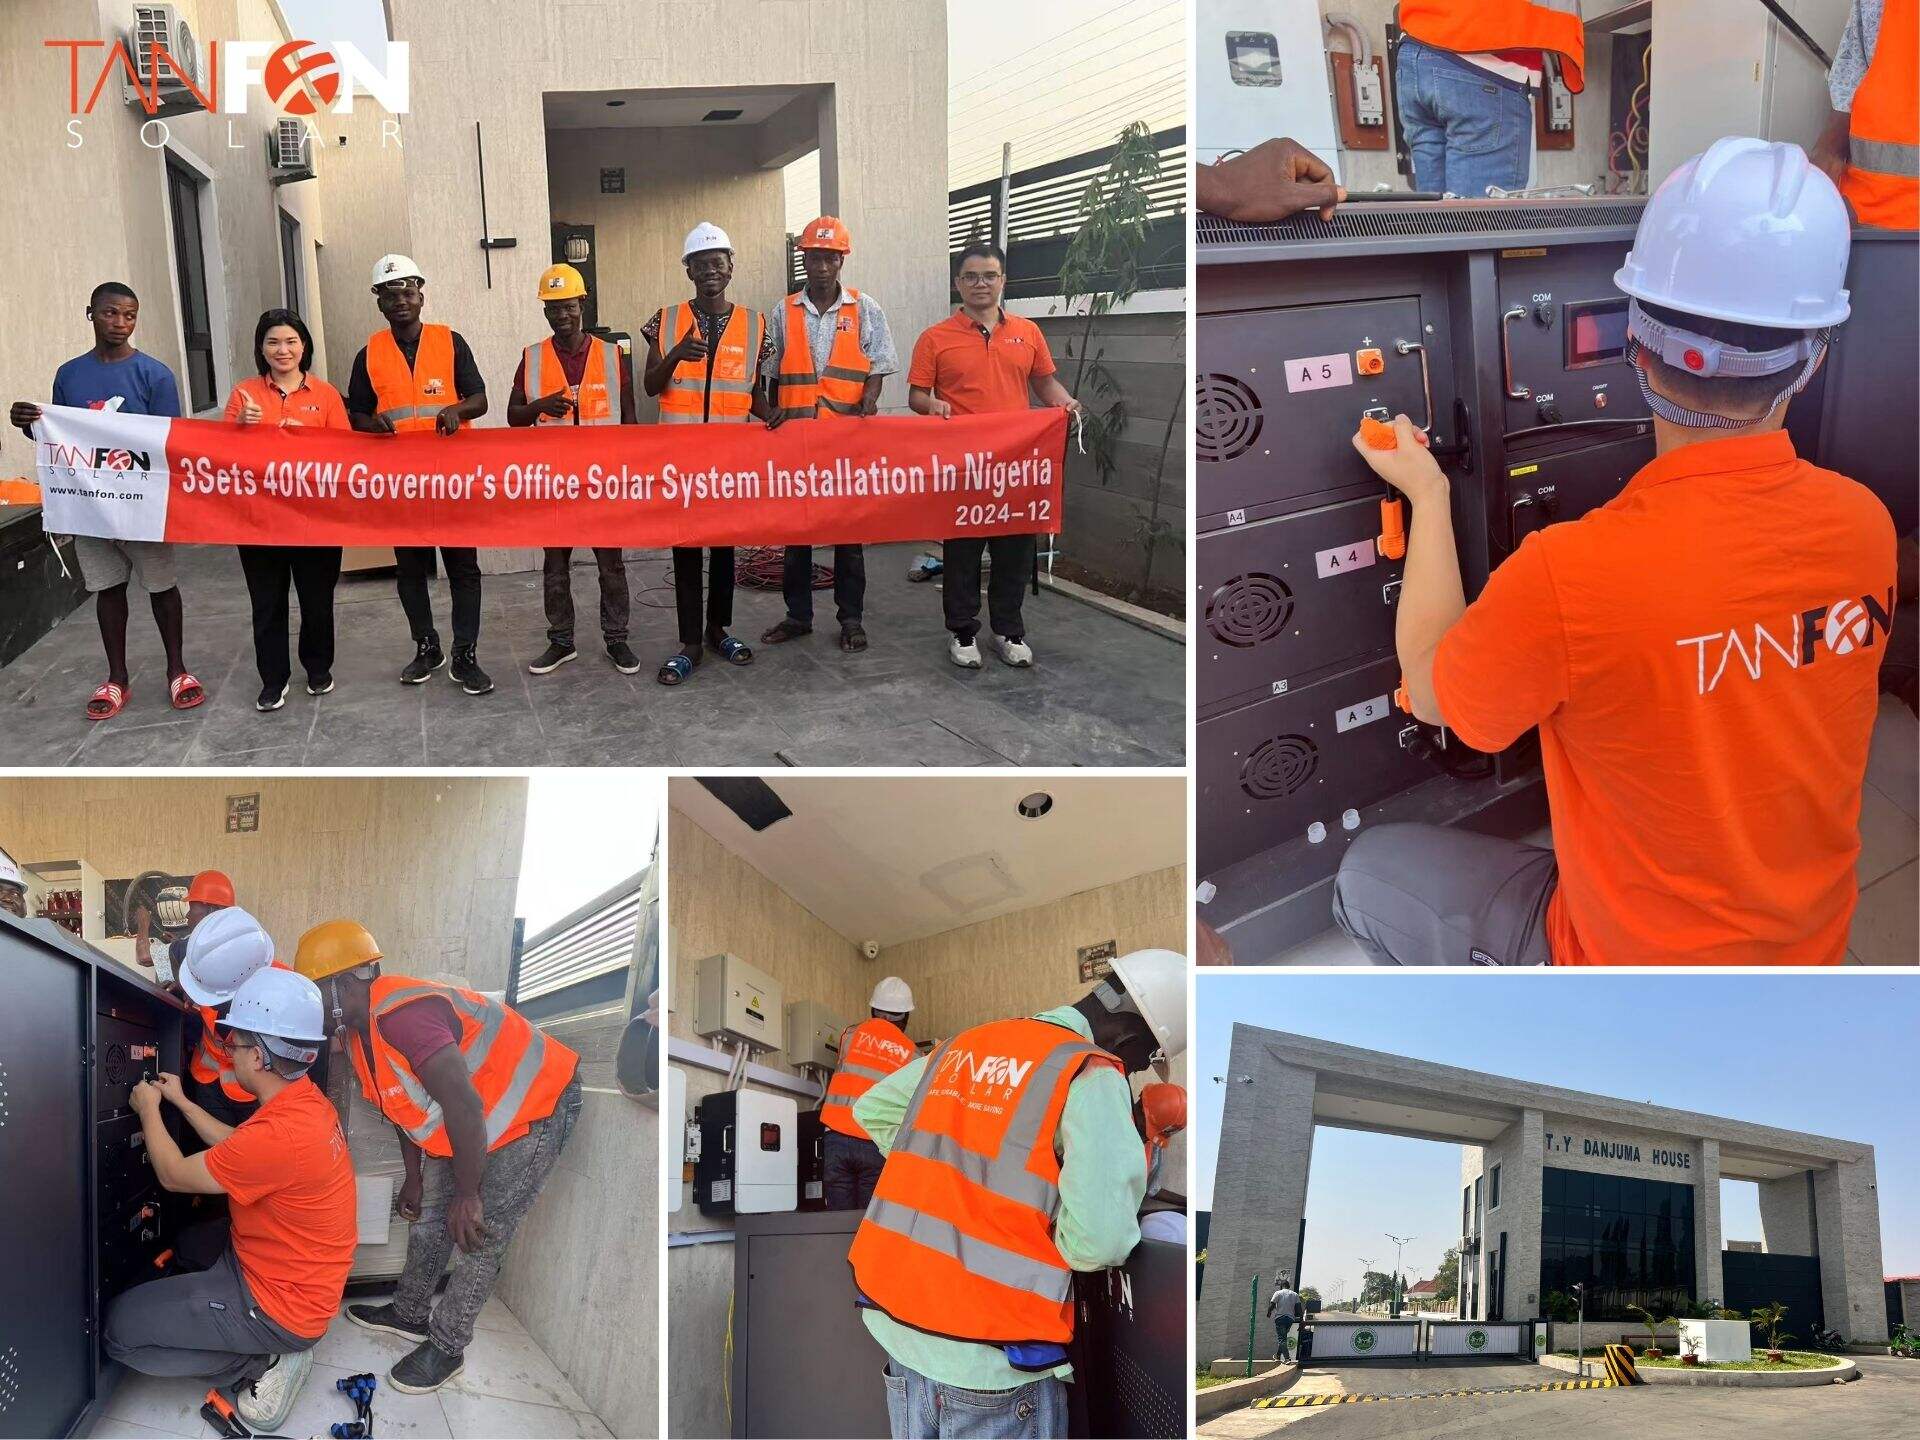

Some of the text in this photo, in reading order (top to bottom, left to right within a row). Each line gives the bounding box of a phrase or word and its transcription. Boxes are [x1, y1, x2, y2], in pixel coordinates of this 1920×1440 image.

[1532, 293, 1552, 303] COM
[1535, 393, 1554, 403] COM
[44, 442, 151, 472] TANFON
[49, 466, 148, 481] SOLAR
[180, 448, 1052, 509] 3Sets 40KW Governor's Office Solar System Installation In Nigeria
[50, 486, 143, 501] www.tanfon.com
[1538, 485, 1555, 495] COM
[1229, 512, 1243, 523] A4
[1675, 584, 1894, 695] TANFON
[1274, 681, 1287, 692] A3
[1584, 1138, 1641, 1162] DANJUMA
[1653, 1148, 1690, 1169] HOUSE
